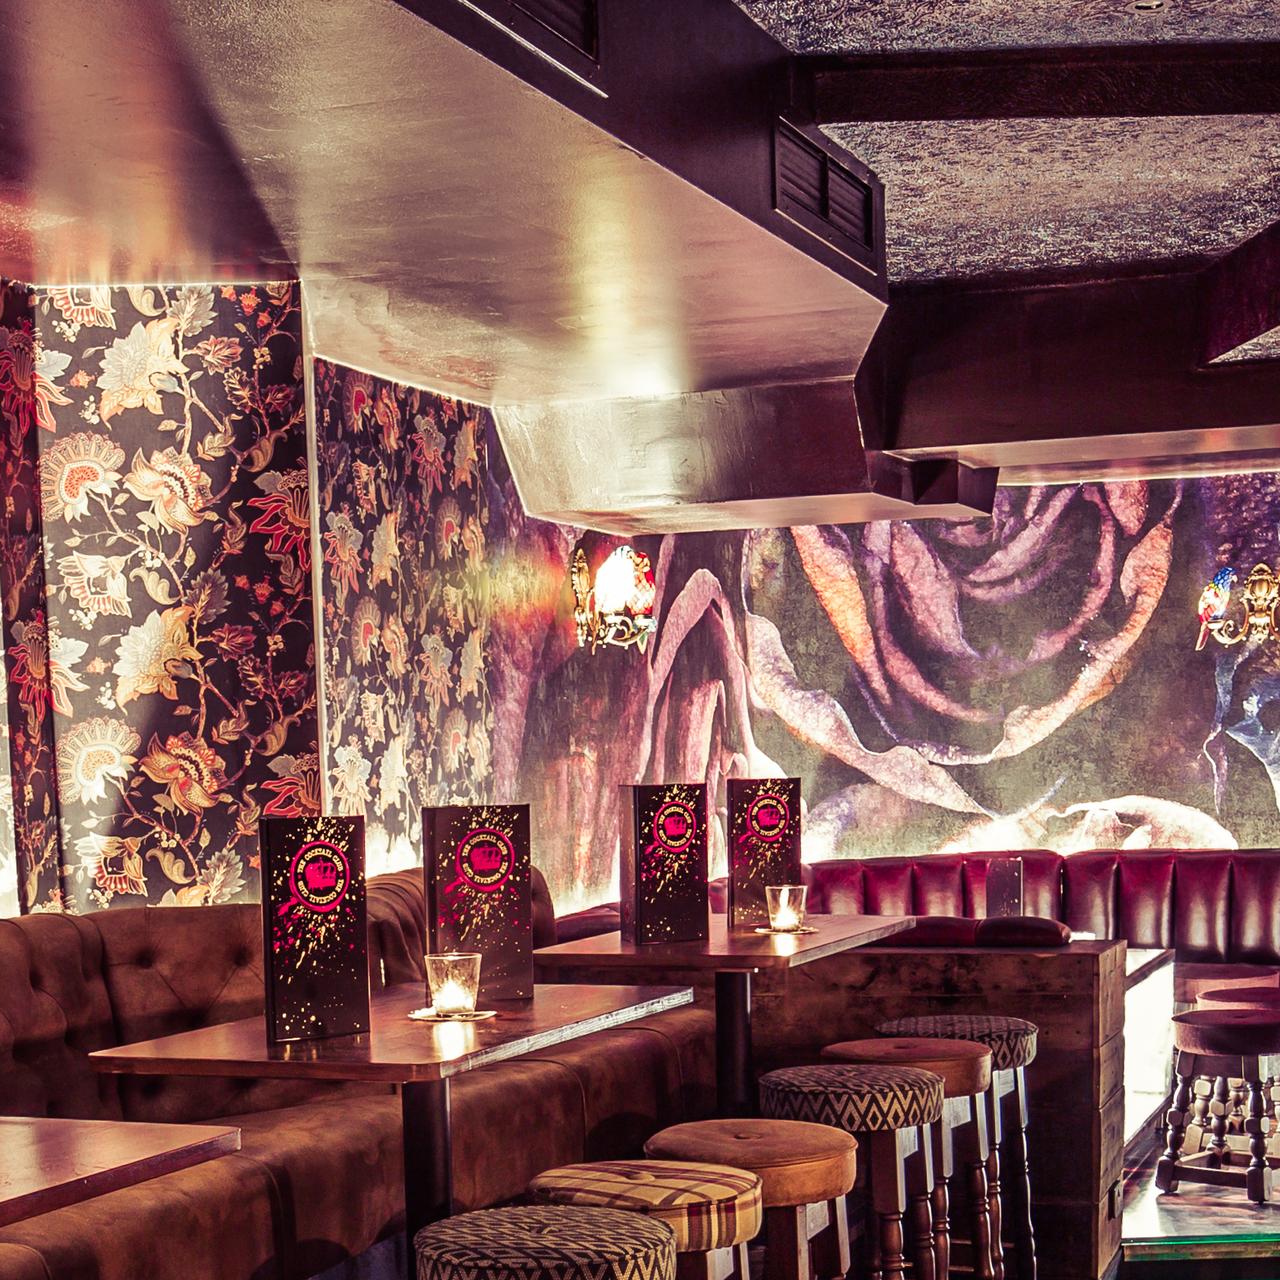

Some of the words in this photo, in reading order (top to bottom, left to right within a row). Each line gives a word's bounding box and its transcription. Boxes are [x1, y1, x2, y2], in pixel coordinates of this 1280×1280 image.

[297, 859, 306, 873] THE
[304, 848, 332, 860] COCKTAIL
[332, 855, 343, 871] CLUB
